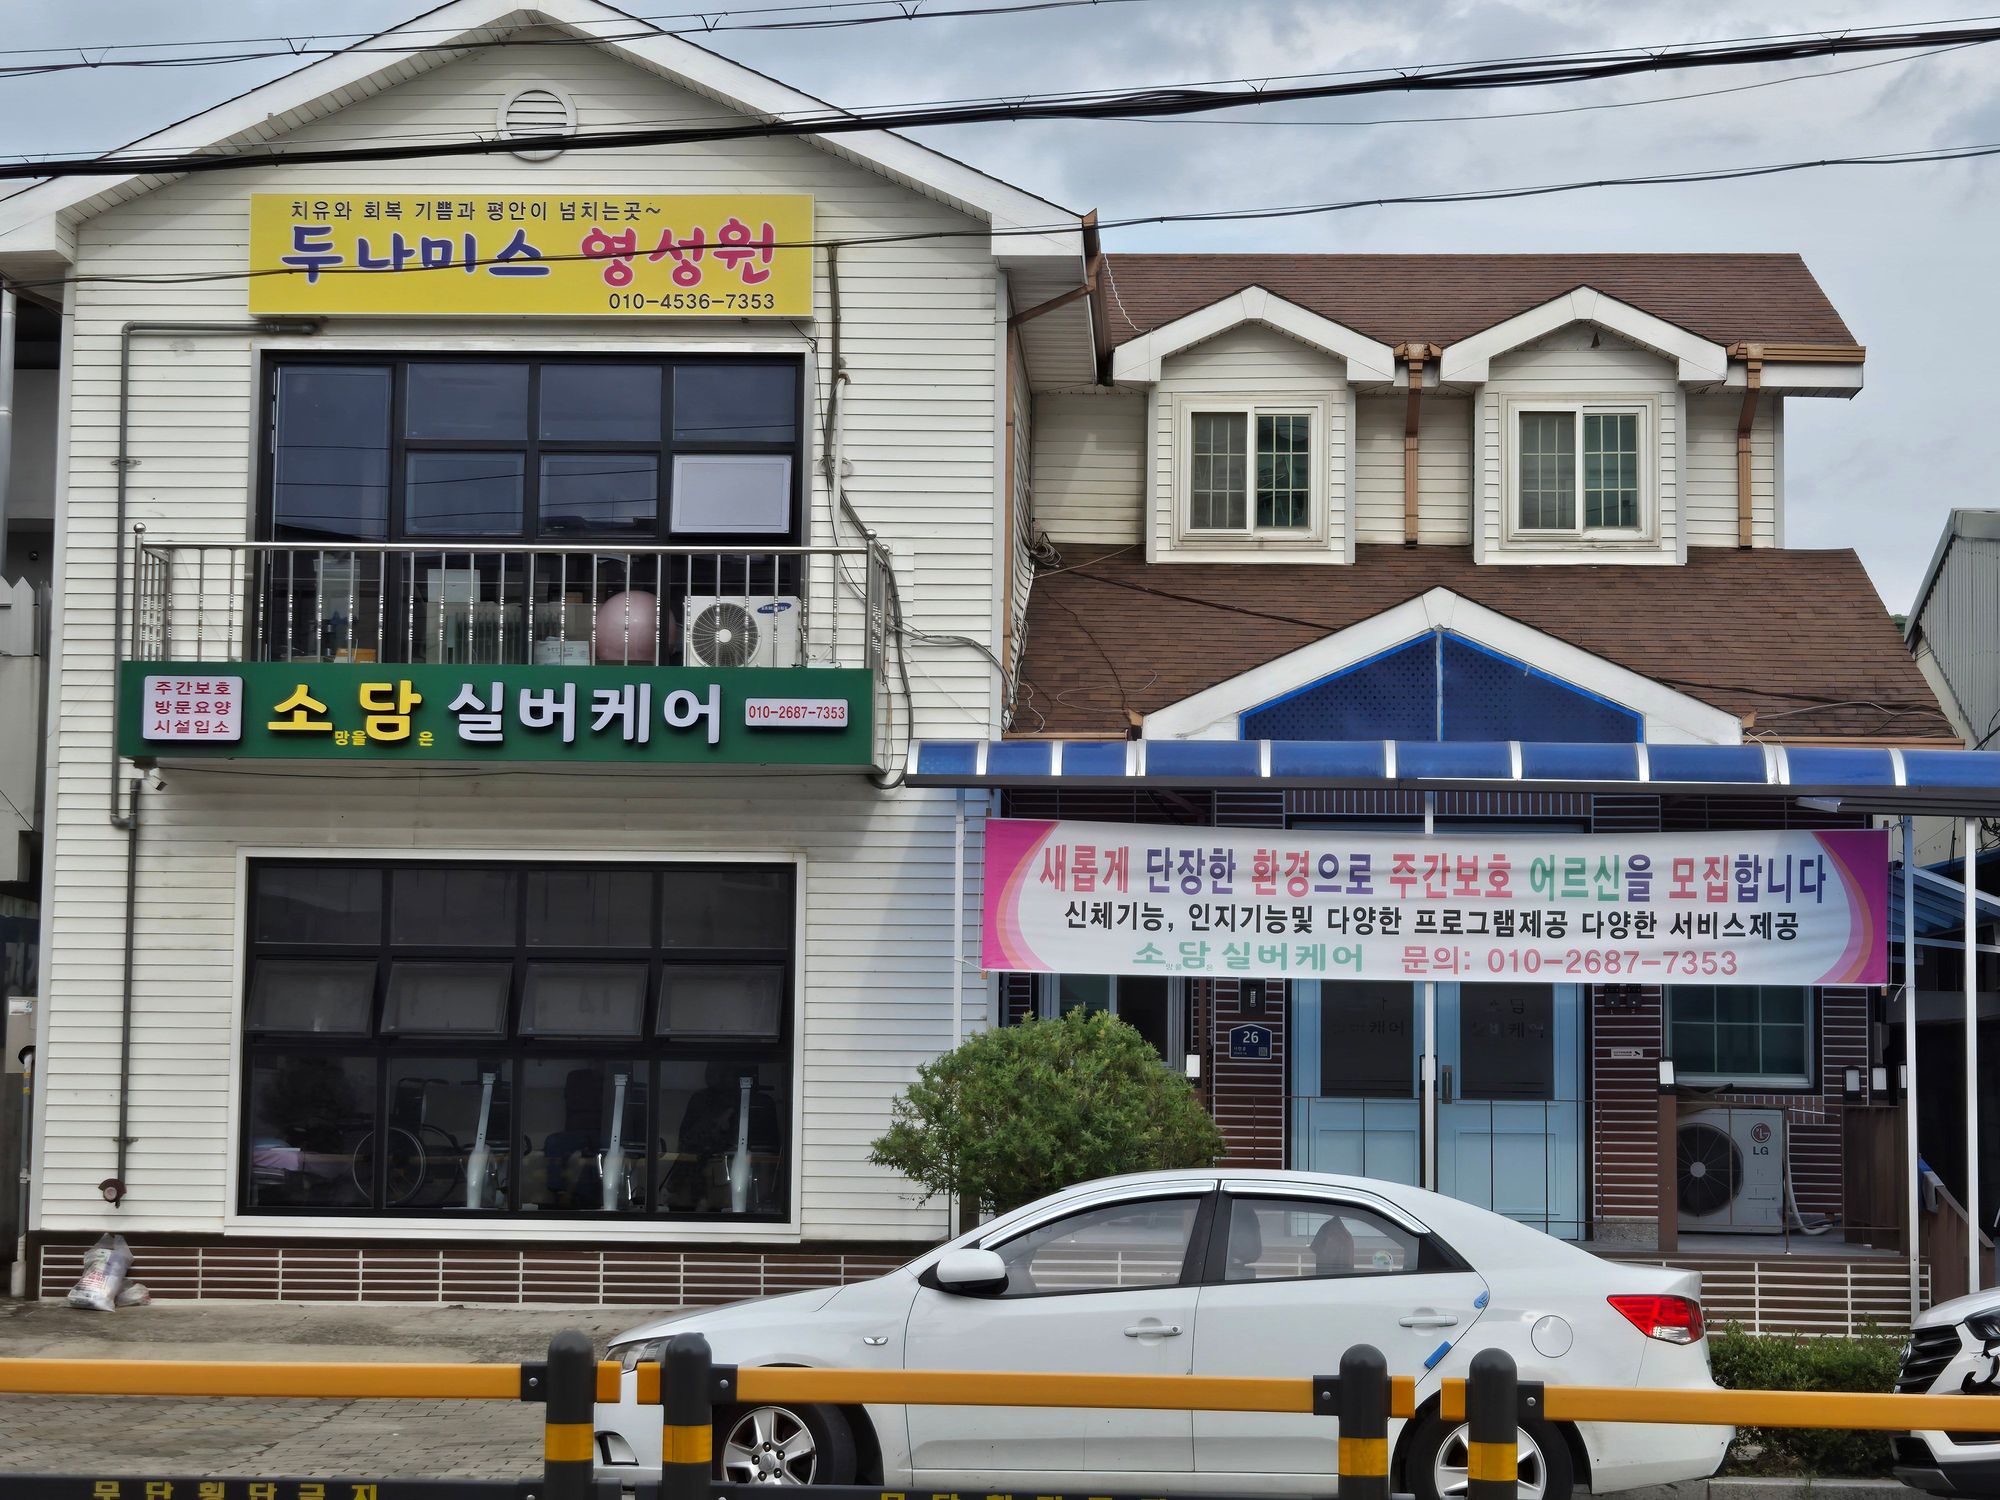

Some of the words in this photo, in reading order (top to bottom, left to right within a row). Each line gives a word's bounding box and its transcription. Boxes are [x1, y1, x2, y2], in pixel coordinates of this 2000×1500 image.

[291, 200, 352, 221] 치유와
[364, 201, 403, 220] 회복
[415, 200, 475, 221] 기쁨과
[487, 201, 547, 222] 평안이
[280, 225, 551, 283] 두나미스
[581, 217, 775, 287] 영성원
[608, 293, 775, 310] 010-4536-7353
[155, 681, 232, 695] 주간보호
[155, 701, 232, 716] 방문요양
[447, 680, 722, 744] 실버케어
[748, 706, 846, 720] 010-2687-7353
[154, 720, 230, 734] 시설입소
[1039, 844, 1130, 894] 새롭게
[1146, 847, 1237, 895] 단장한
[1251, 848, 1374, 897] 환경으로
[1389, 853, 1512, 898] 주간보호
[1529, 854, 1653, 903] 어르신을
[1668, 853, 1826, 904] 모집합니다
[1064, 901, 1174, 933] 신체기능,
[1188, 903, 1314, 934] 인지기능및
[1327, 905, 1403, 935] 다양한
[1414, 909, 1569, 939] 프로그램제공
[1581, 910, 1657, 940] 다양한
[1669, 911, 1799, 941] 서비스제공
[1221, 942, 1363, 973] 실버케어
[1401, 945, 1471, 975] 문의:
[1487, 948, 1738, 976] 010-2687-7353
[1243, 1031, 1259, 1043] 26
[1752, 1146, 1769, 1155] LG
